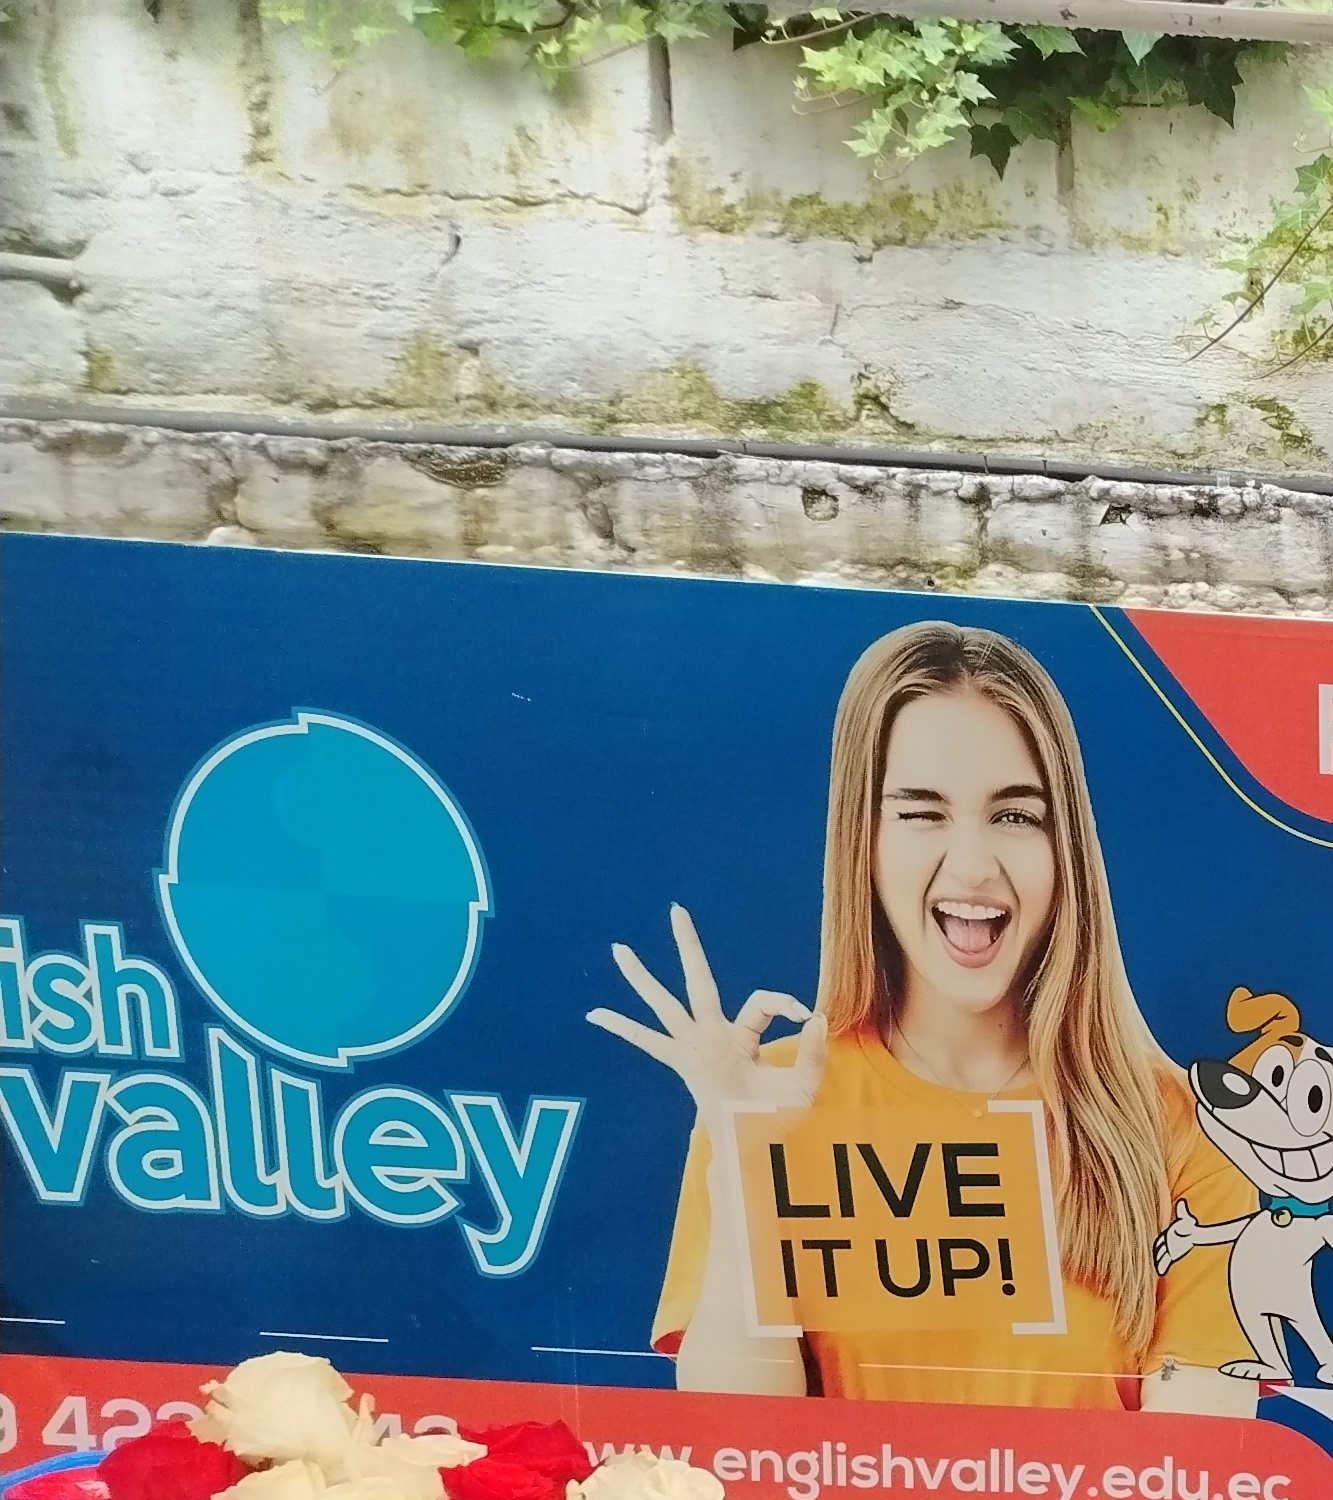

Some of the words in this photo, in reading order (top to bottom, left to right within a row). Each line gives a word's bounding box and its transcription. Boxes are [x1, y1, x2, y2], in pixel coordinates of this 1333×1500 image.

[0, 1024, 587, 1275] valley
[769, 1142, 1006, 1219] LIVE
[780, 1238, 852, 1298] IT
[875, 1238, 1016, 1298] UP!
